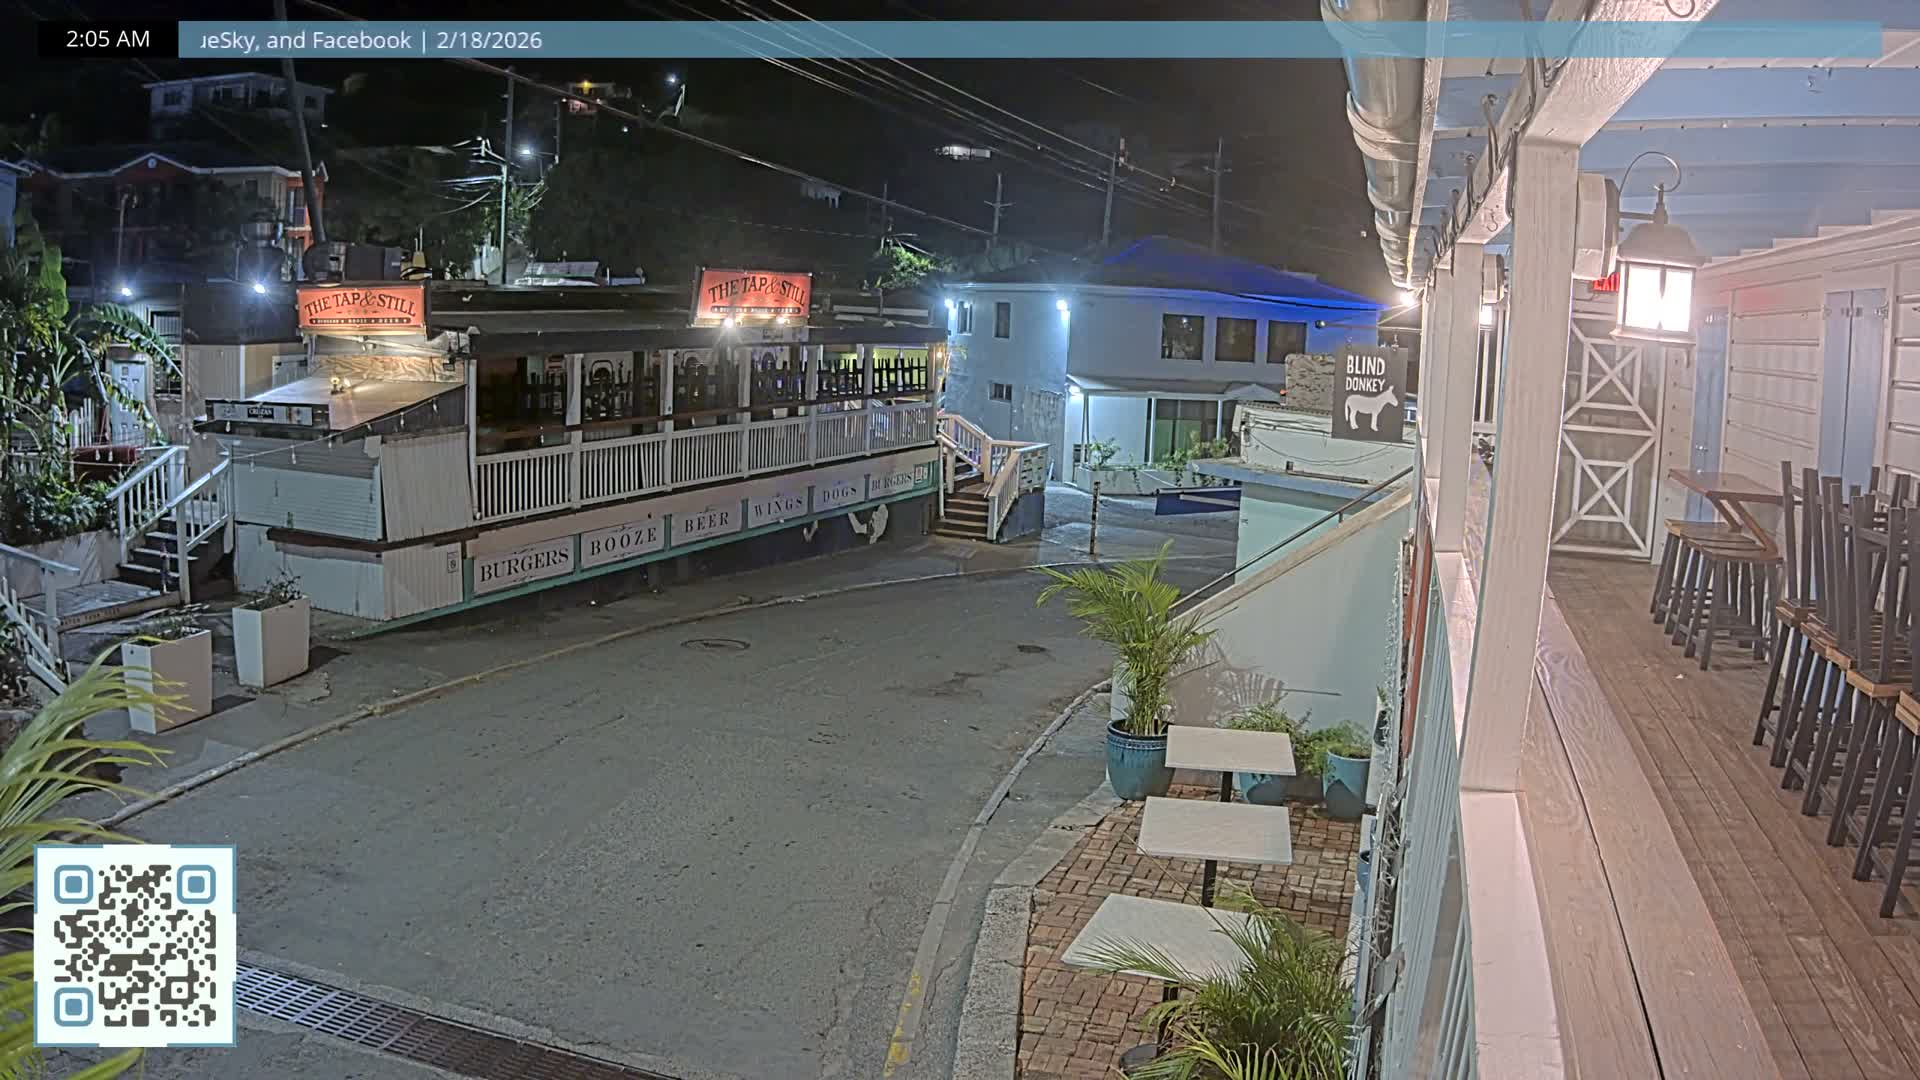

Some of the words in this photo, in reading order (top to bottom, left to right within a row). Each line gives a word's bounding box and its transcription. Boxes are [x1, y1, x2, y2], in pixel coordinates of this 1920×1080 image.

[708, 279, 740, 303] THE
[742, 276, 768, 294] TAP
[765, 276, 780, 295] &
[779, 280, 805, 307] STILL
[304, 296, 332, 317] THE
[332, 292, 361, 307] TAP
[360, 290, 377, 308] &
[377, 293, 417, 317] STILL
[1346, 355, 1386, 376] BLIND
[1345, 376, 1386, 392] DONKEY
[823, 487, 857, 503] DOGS
[754, 496, 803, 518] WINGS
[684, 511, 729, 534] BEER
[590, 527, 658, 556] BOOZE
[480, 548, 569, 582] BURGERS
